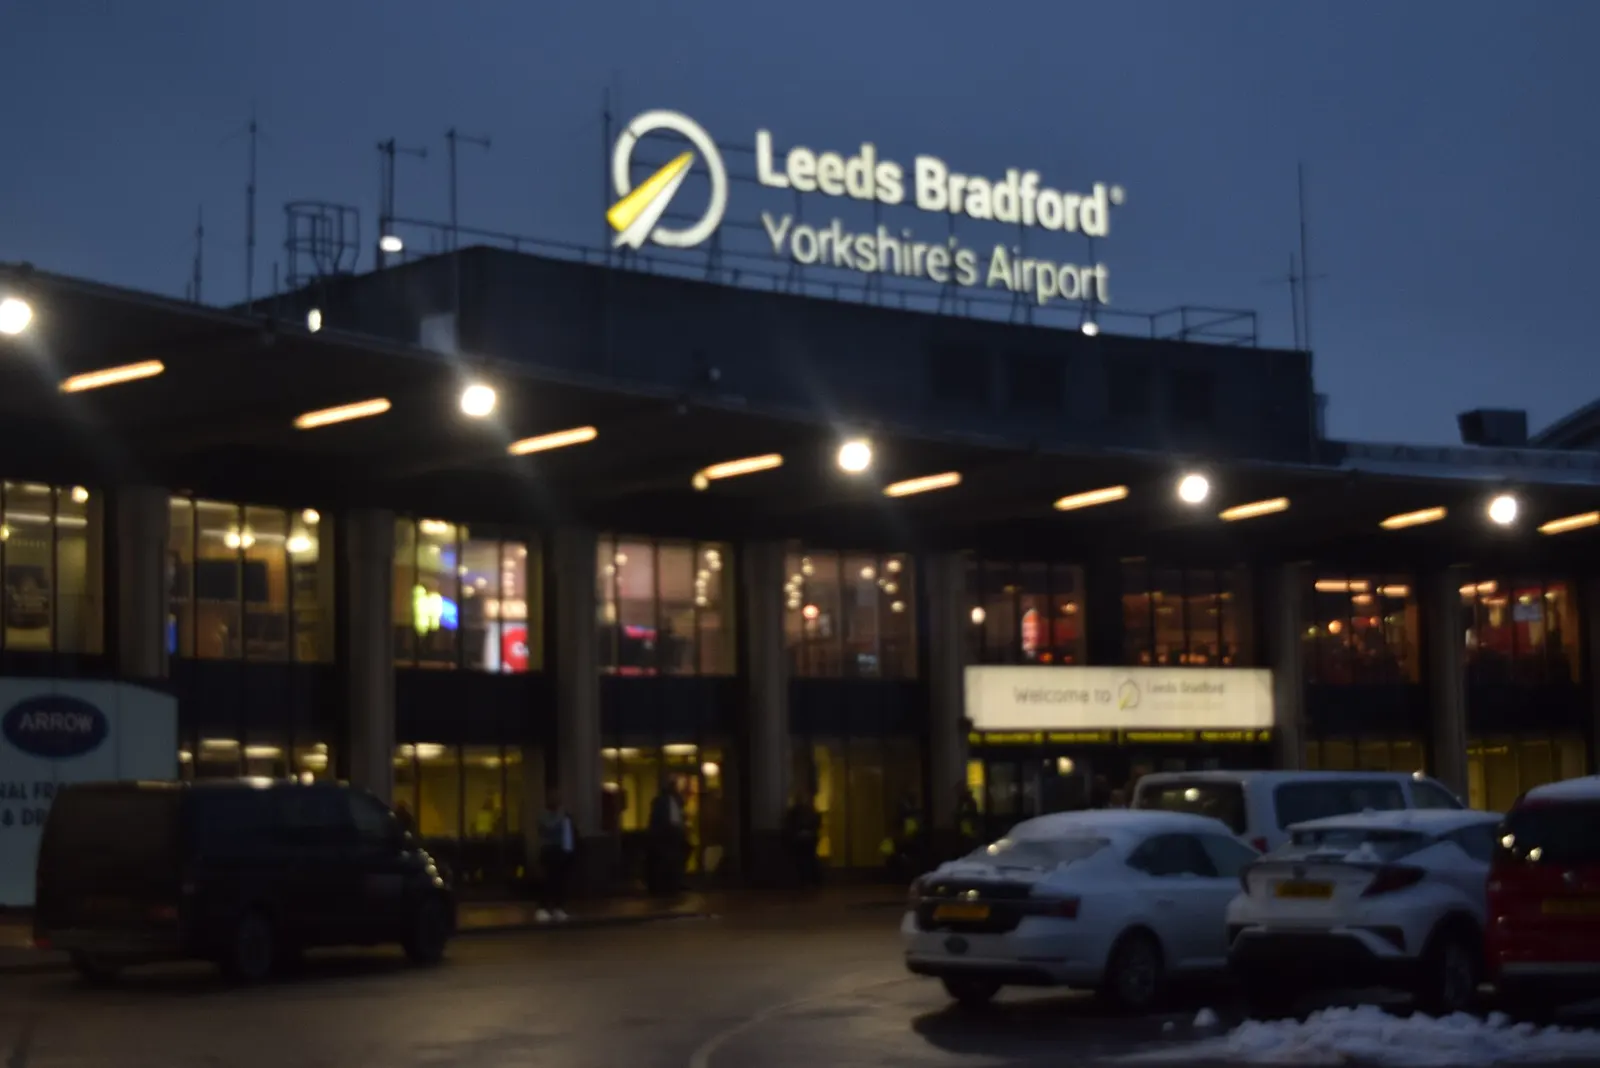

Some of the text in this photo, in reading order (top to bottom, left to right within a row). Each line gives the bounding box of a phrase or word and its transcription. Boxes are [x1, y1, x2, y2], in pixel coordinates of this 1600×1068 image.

[755, 130, 1110, 237] Leeds Bradford
[762, 211, 1110, 304] Yorkshire's Airport
[19, 709, 94, 734] ARROW
[1013, 684, 1112, 704] Welcome to
